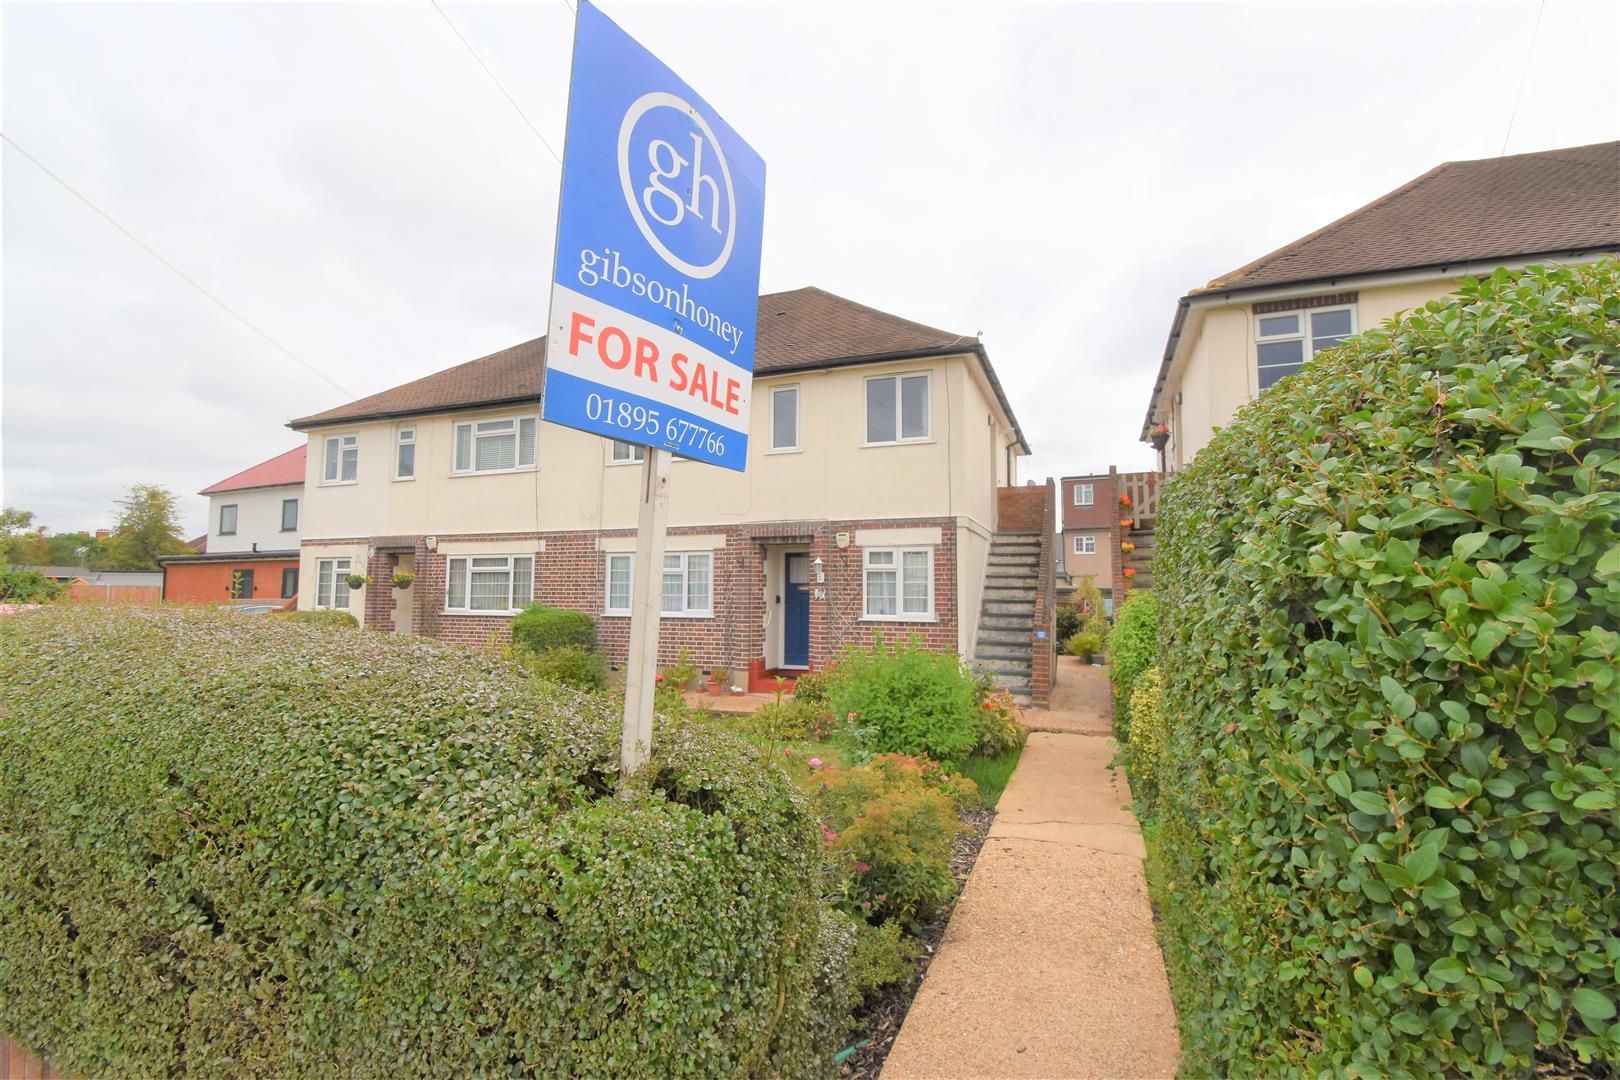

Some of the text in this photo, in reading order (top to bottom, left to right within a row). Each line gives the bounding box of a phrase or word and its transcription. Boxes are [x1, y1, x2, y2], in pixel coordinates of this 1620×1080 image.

[643, 132, 722, 236] gh
[577, 248, 744, 354] gibsonhoney
[568, 311, 741, 416] FOR SALE
[586, 393, 725, 456] 01895 677766
